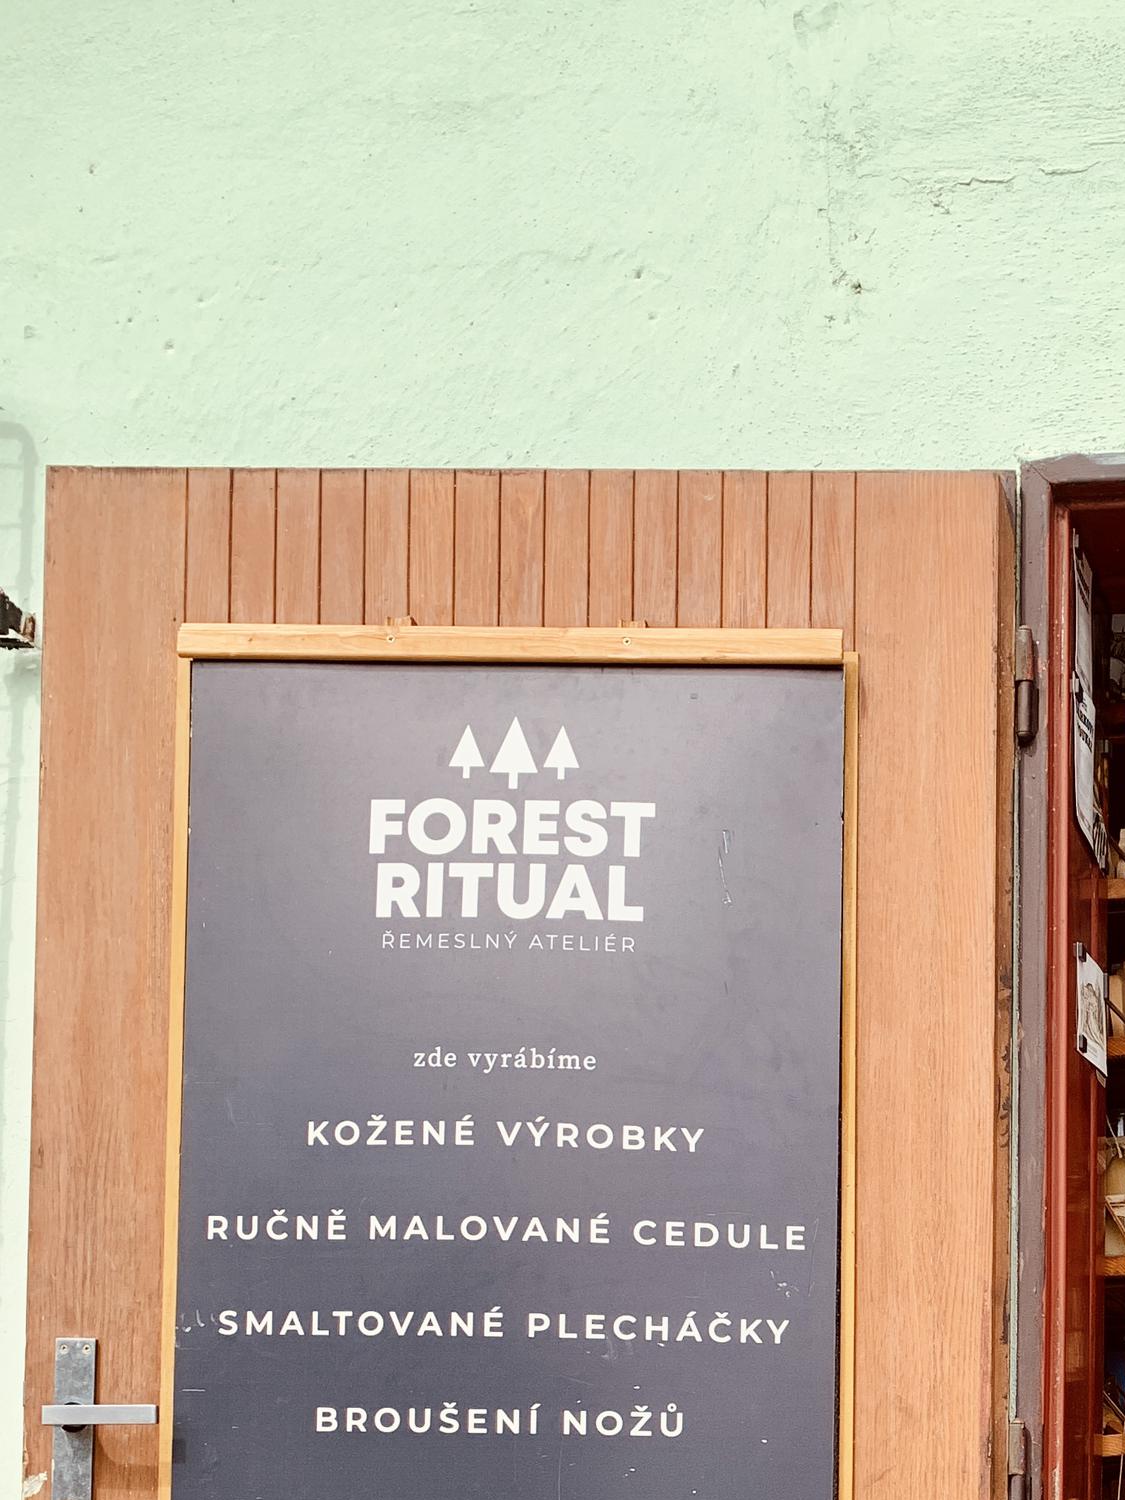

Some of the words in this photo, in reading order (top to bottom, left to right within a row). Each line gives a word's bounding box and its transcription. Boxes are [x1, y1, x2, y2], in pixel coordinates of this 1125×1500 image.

[369, 798, 656, 857] FOREST
[376, 863, 643, 922] RITUAL
[383, 930, 517, 948] ŘEMESLNÝ
[529, 934, 634, 952] ATELIÉR
[414, 1047, 456, 1067] zde
[468, 1047, 596, 1073] vyrábíme
[308, 1115, 474, 1145] KOŽENÉ
[497, 1116, 704, 1152] VÝROBKY
[208, 1209, 346, 1240] RUČNĚ
[370, 1213, 609, 1243] MALOVANÉ
[634, 1220, 805, 1250] CEDULE
[219, 1306, 503, 1337] SMALTOVANÉ
[529, 1311, 789, 1344] PLECHÁČKY
[316, 1402, 541, 1434] BROUŠENÍ
[564, 1403, 683, 1437] NOŽŮ
